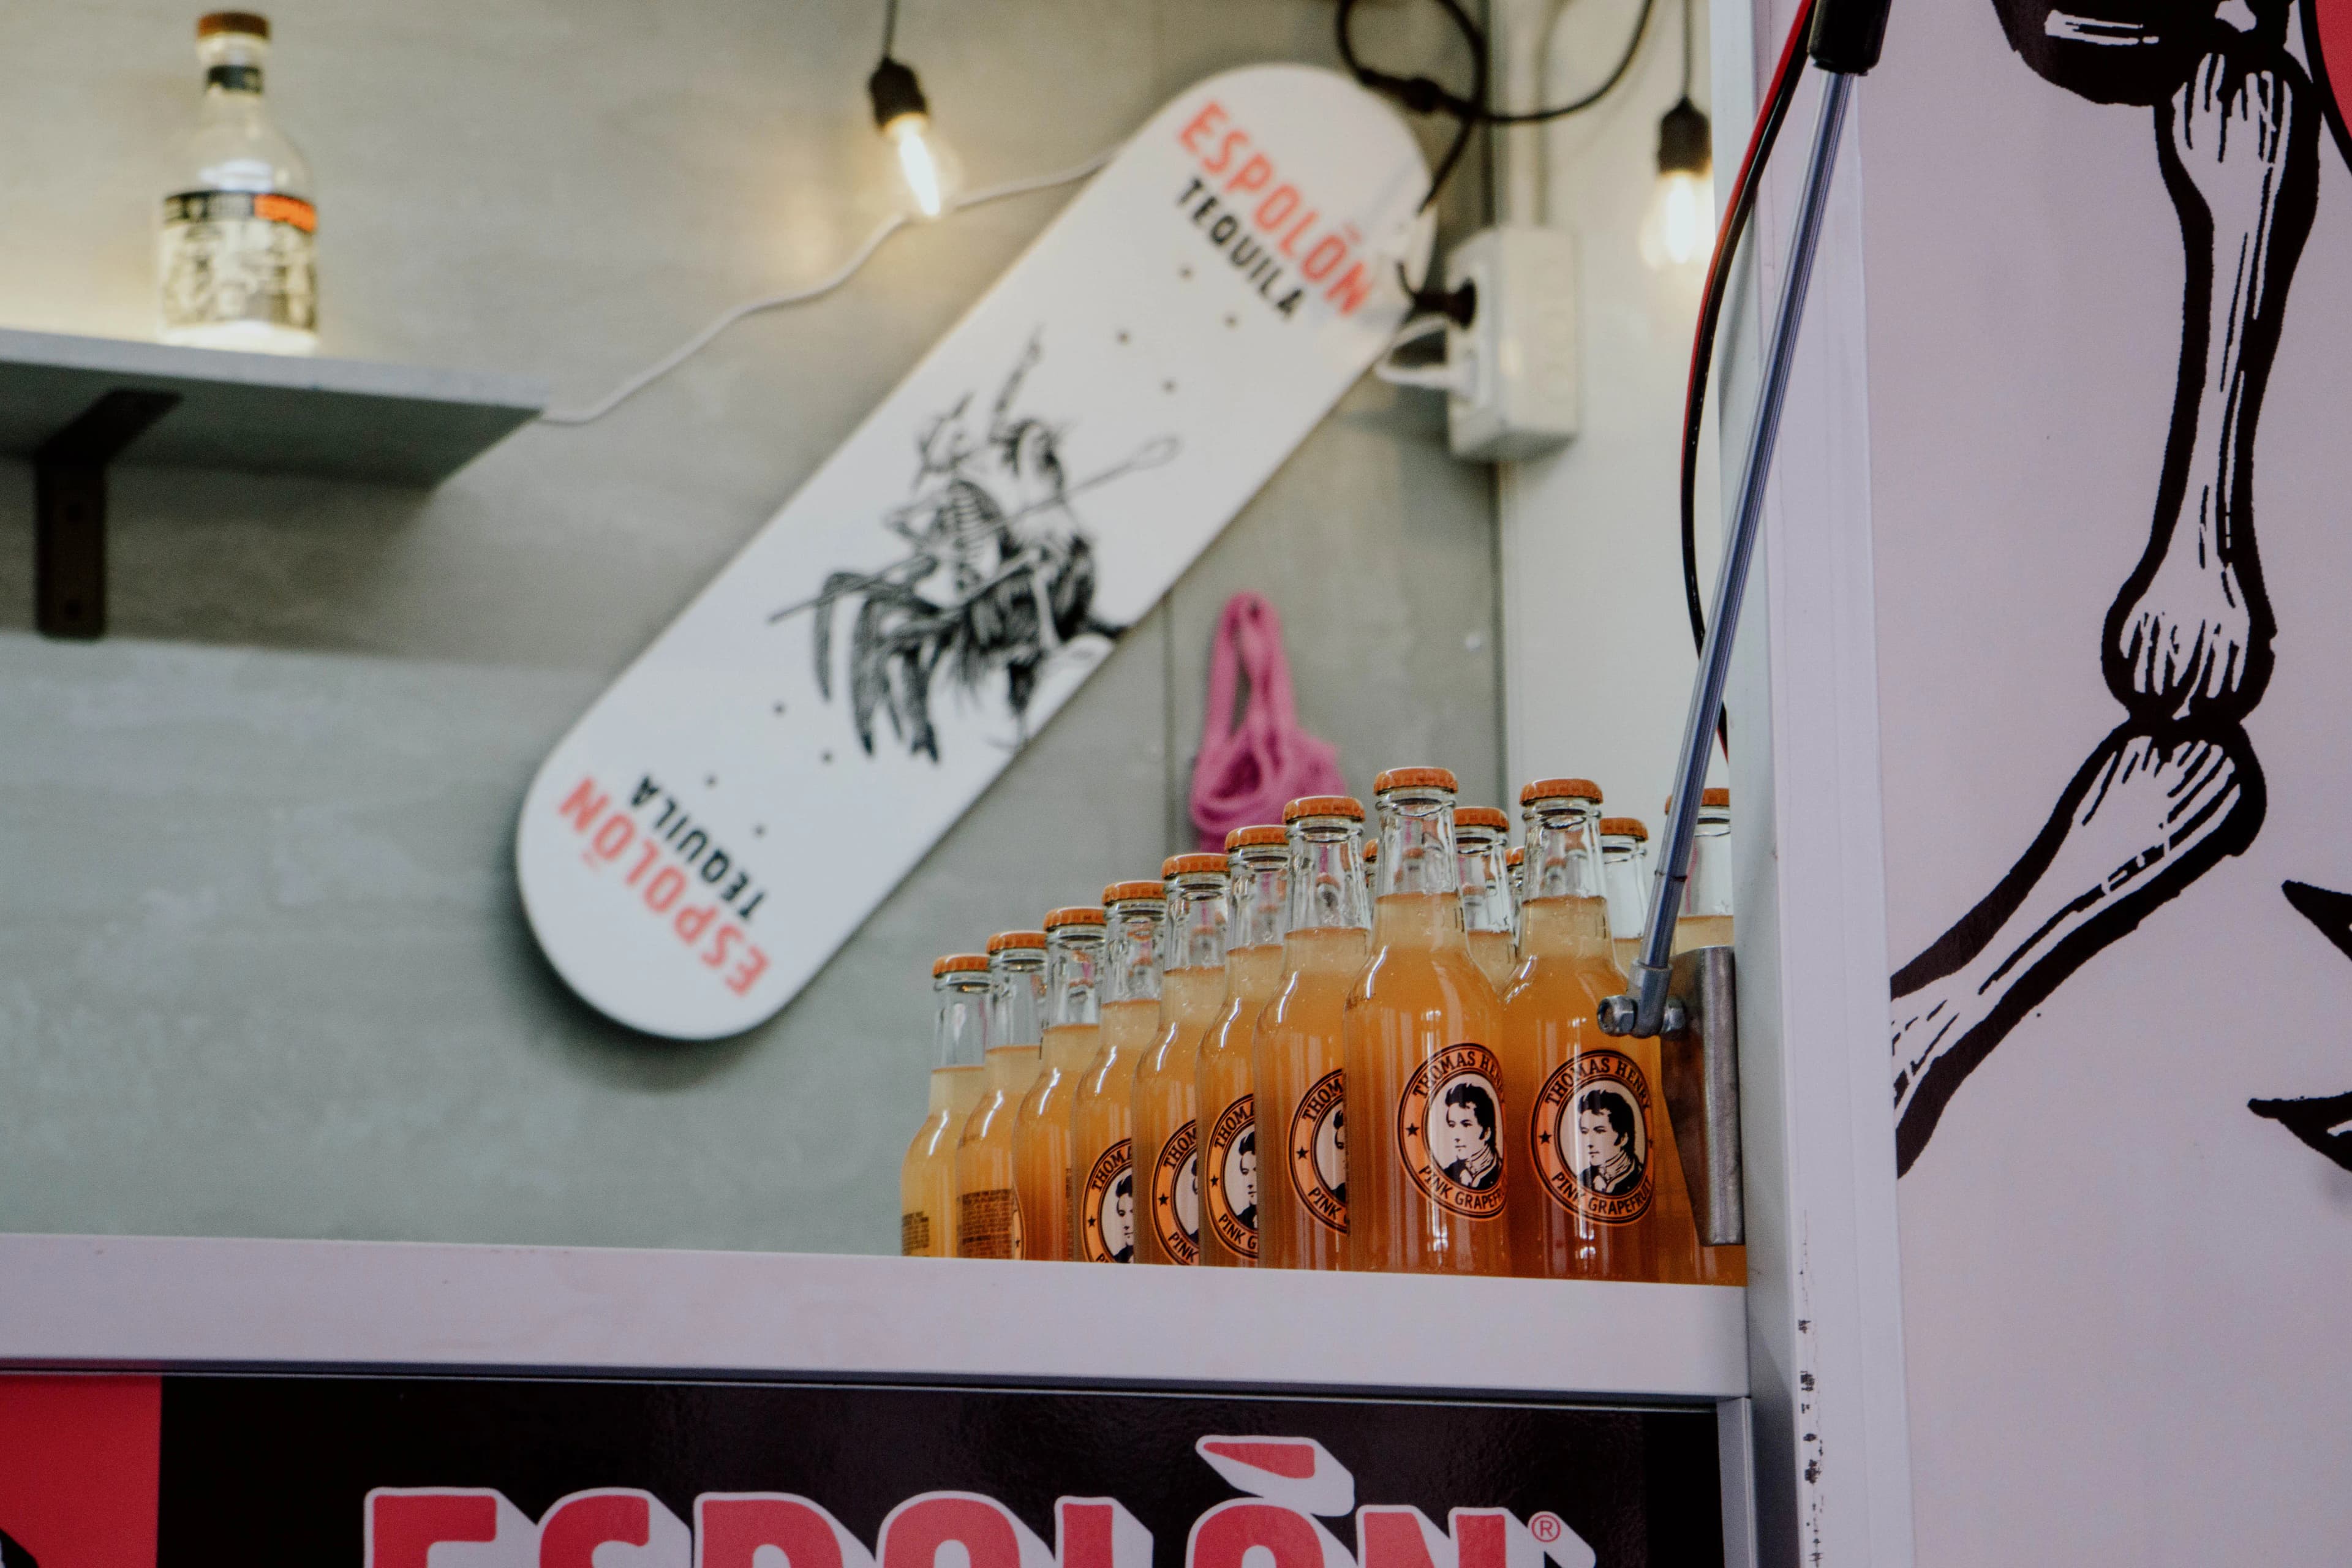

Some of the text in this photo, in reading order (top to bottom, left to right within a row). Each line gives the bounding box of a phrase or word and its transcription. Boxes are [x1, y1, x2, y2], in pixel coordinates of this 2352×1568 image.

[1176, 178, 1303, 321] TEQUILA
[630, 775, 765, 923] TEQUILA
[1412, 1050, 1475, 1098] THOMAS
[1545, 1057, 1610, 1106] THOMAS
[1419, 1165, 1453, 1199] PINK
[1308, 1187, 1342, 1220] PINK
[1168, 1231, 1199, 1263] PINK
[1218, 1213, 1246, 1244] PINK
